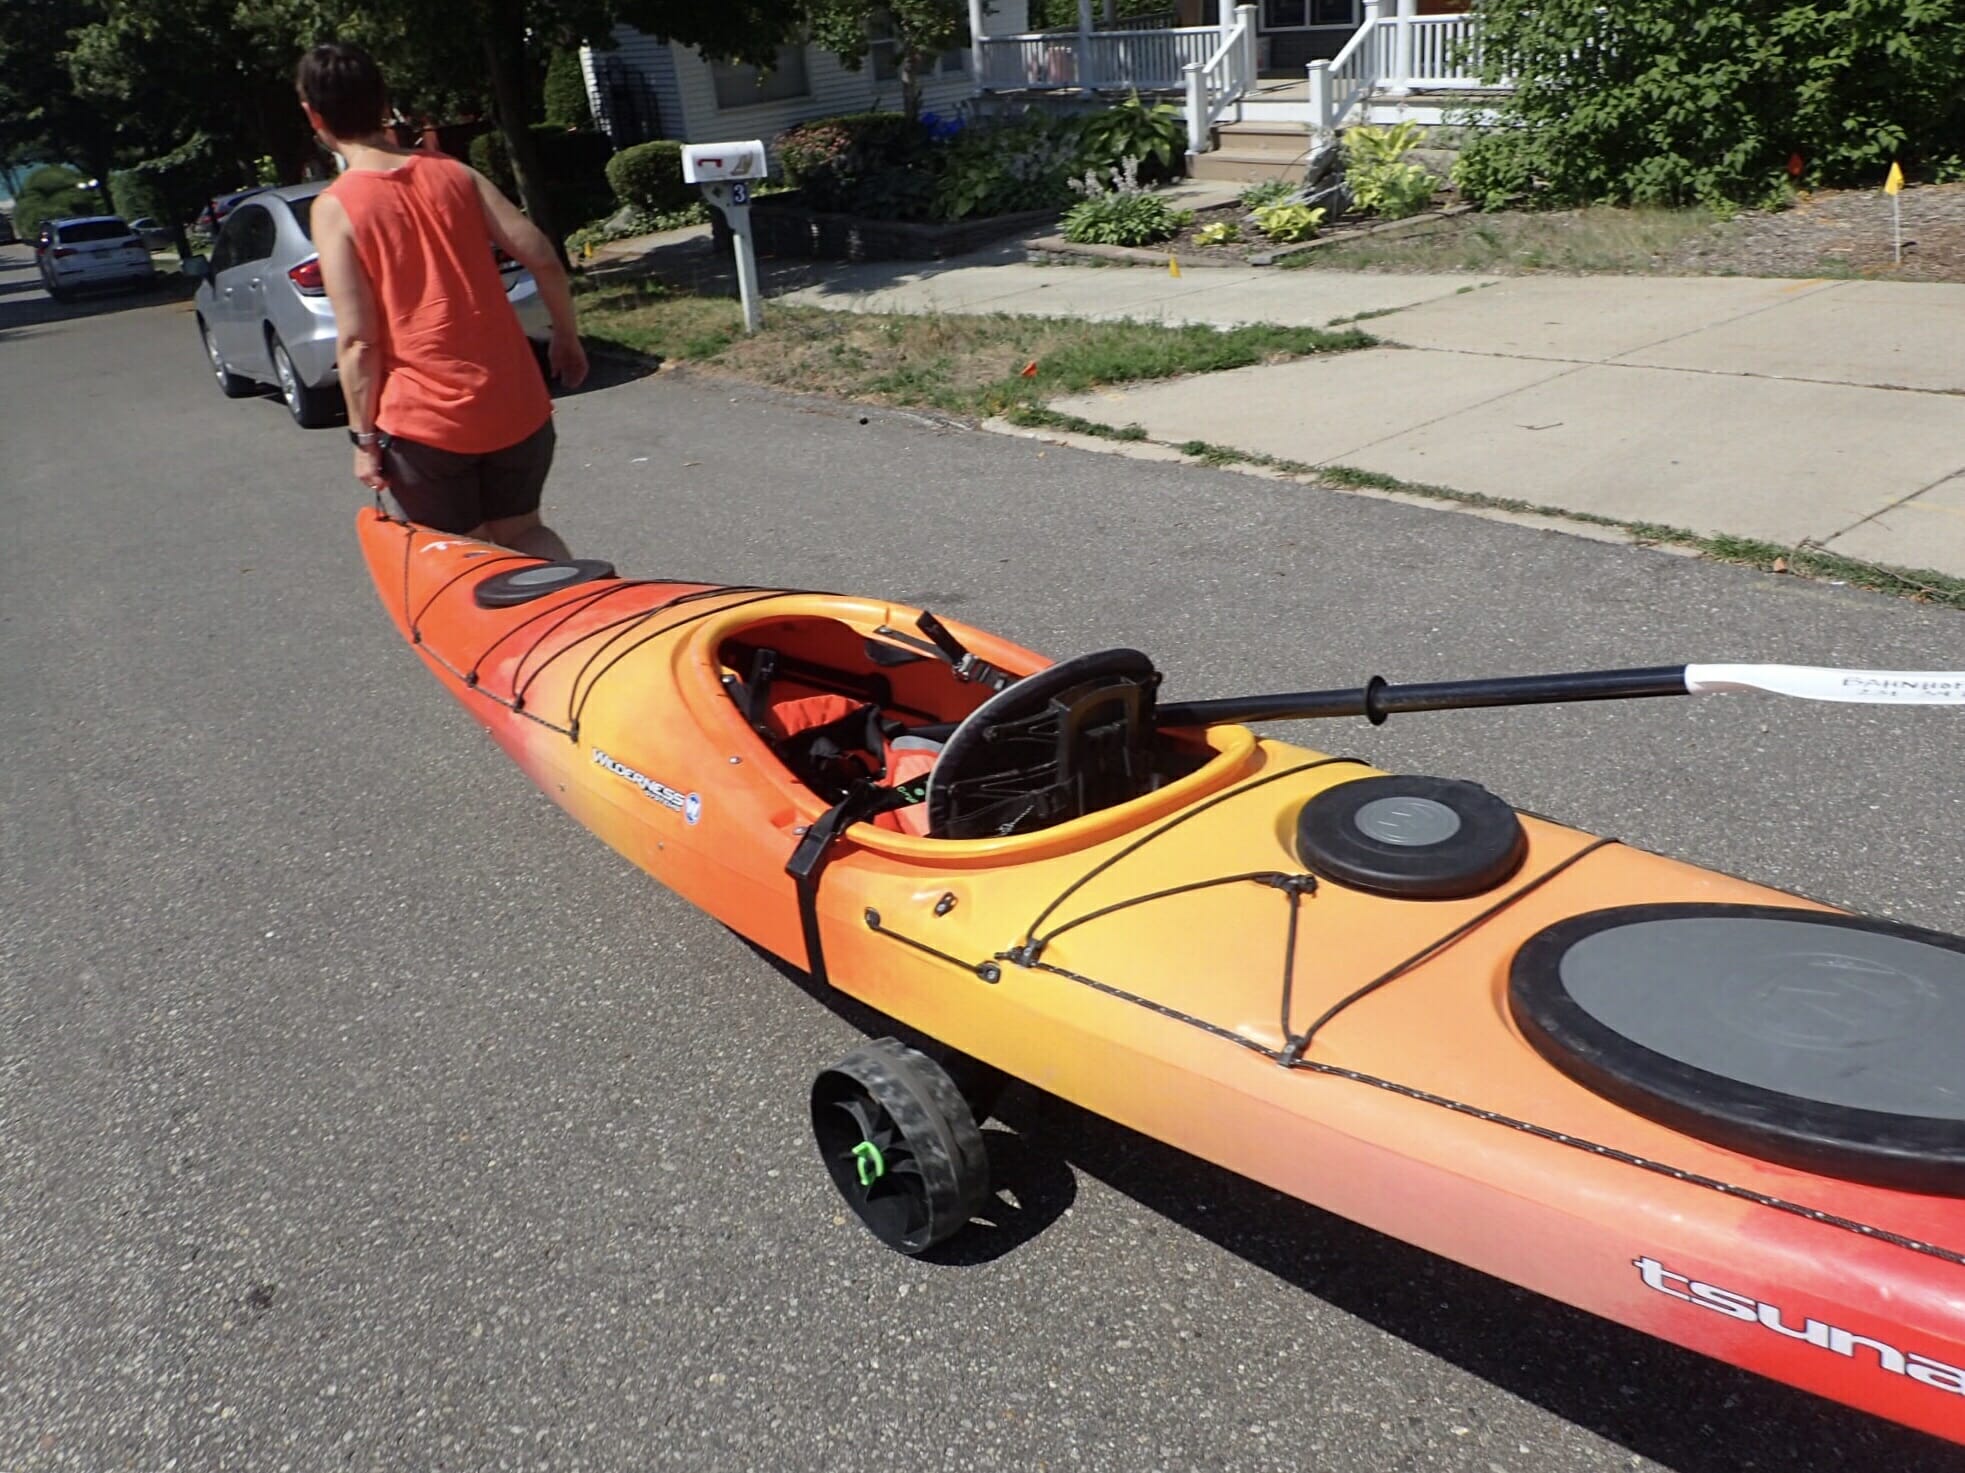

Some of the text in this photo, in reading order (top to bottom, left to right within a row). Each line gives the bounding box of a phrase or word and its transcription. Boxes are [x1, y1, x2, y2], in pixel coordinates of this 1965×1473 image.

[734, 184, 745, 202] 3
[594, 749, 685, 808] WILDERNESS
[1632, 1255, 1965, 1396] tsuna
